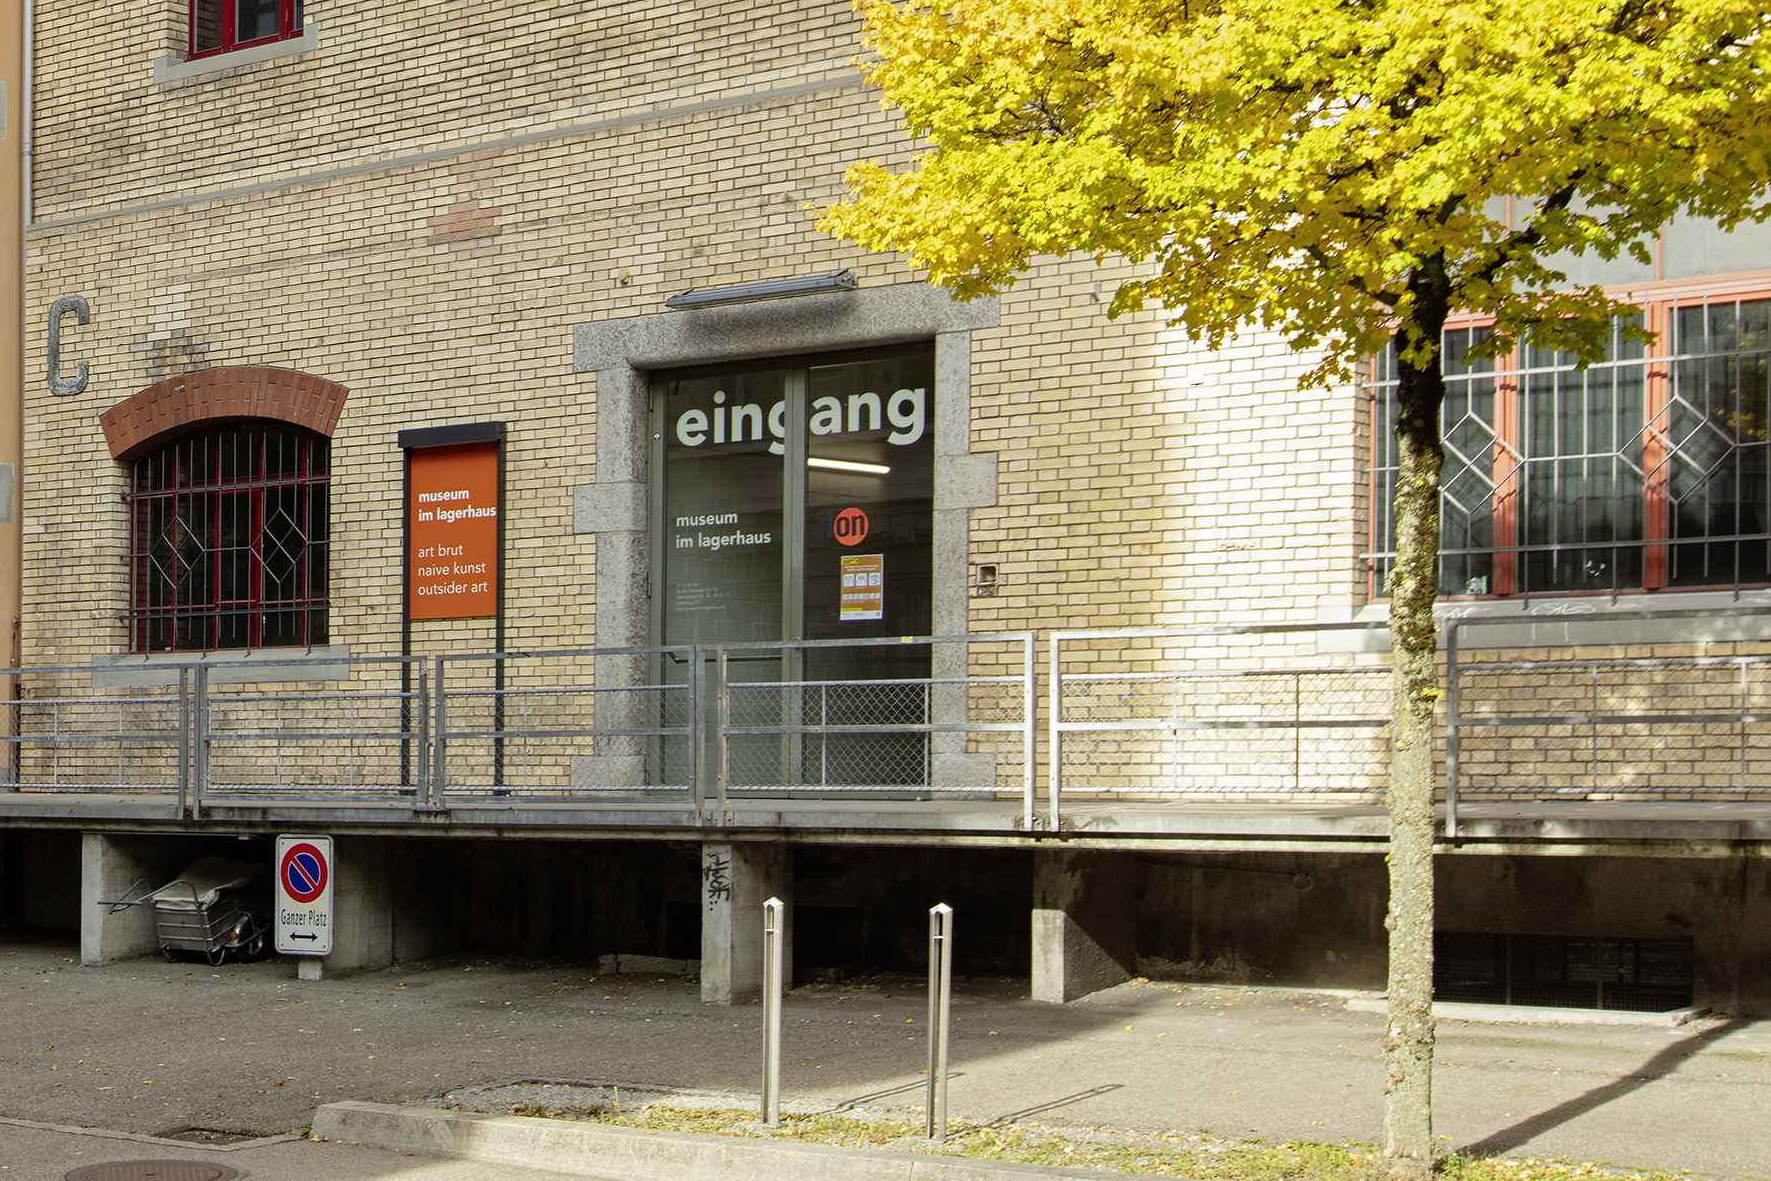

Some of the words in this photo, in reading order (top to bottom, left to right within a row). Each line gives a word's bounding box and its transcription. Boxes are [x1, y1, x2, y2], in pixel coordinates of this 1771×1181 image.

[48, 295, 90, 396] C
[675, 387, 926, 456] eingang
[418, 489, 470, 503] museum
[418, 508, 434, 522] im
[436, 504, 497, 524] lagerhaus
[675, 512, 739, 528] museum
[675, 533, 694, 549] im
[697, 530, 772, 551] lagerhaus
[418, 546, 435, 558] art
[438, 543, 464, 557] brut
[418, 563, 450, 577] naive
[453, 561, 487, 575] kunst
[418, 580, 468, 596] outsider
[470, 581, 488, 593] art
[281, 909, 306, 925] Ganzer
[308, 909, 327, 926] Platz
